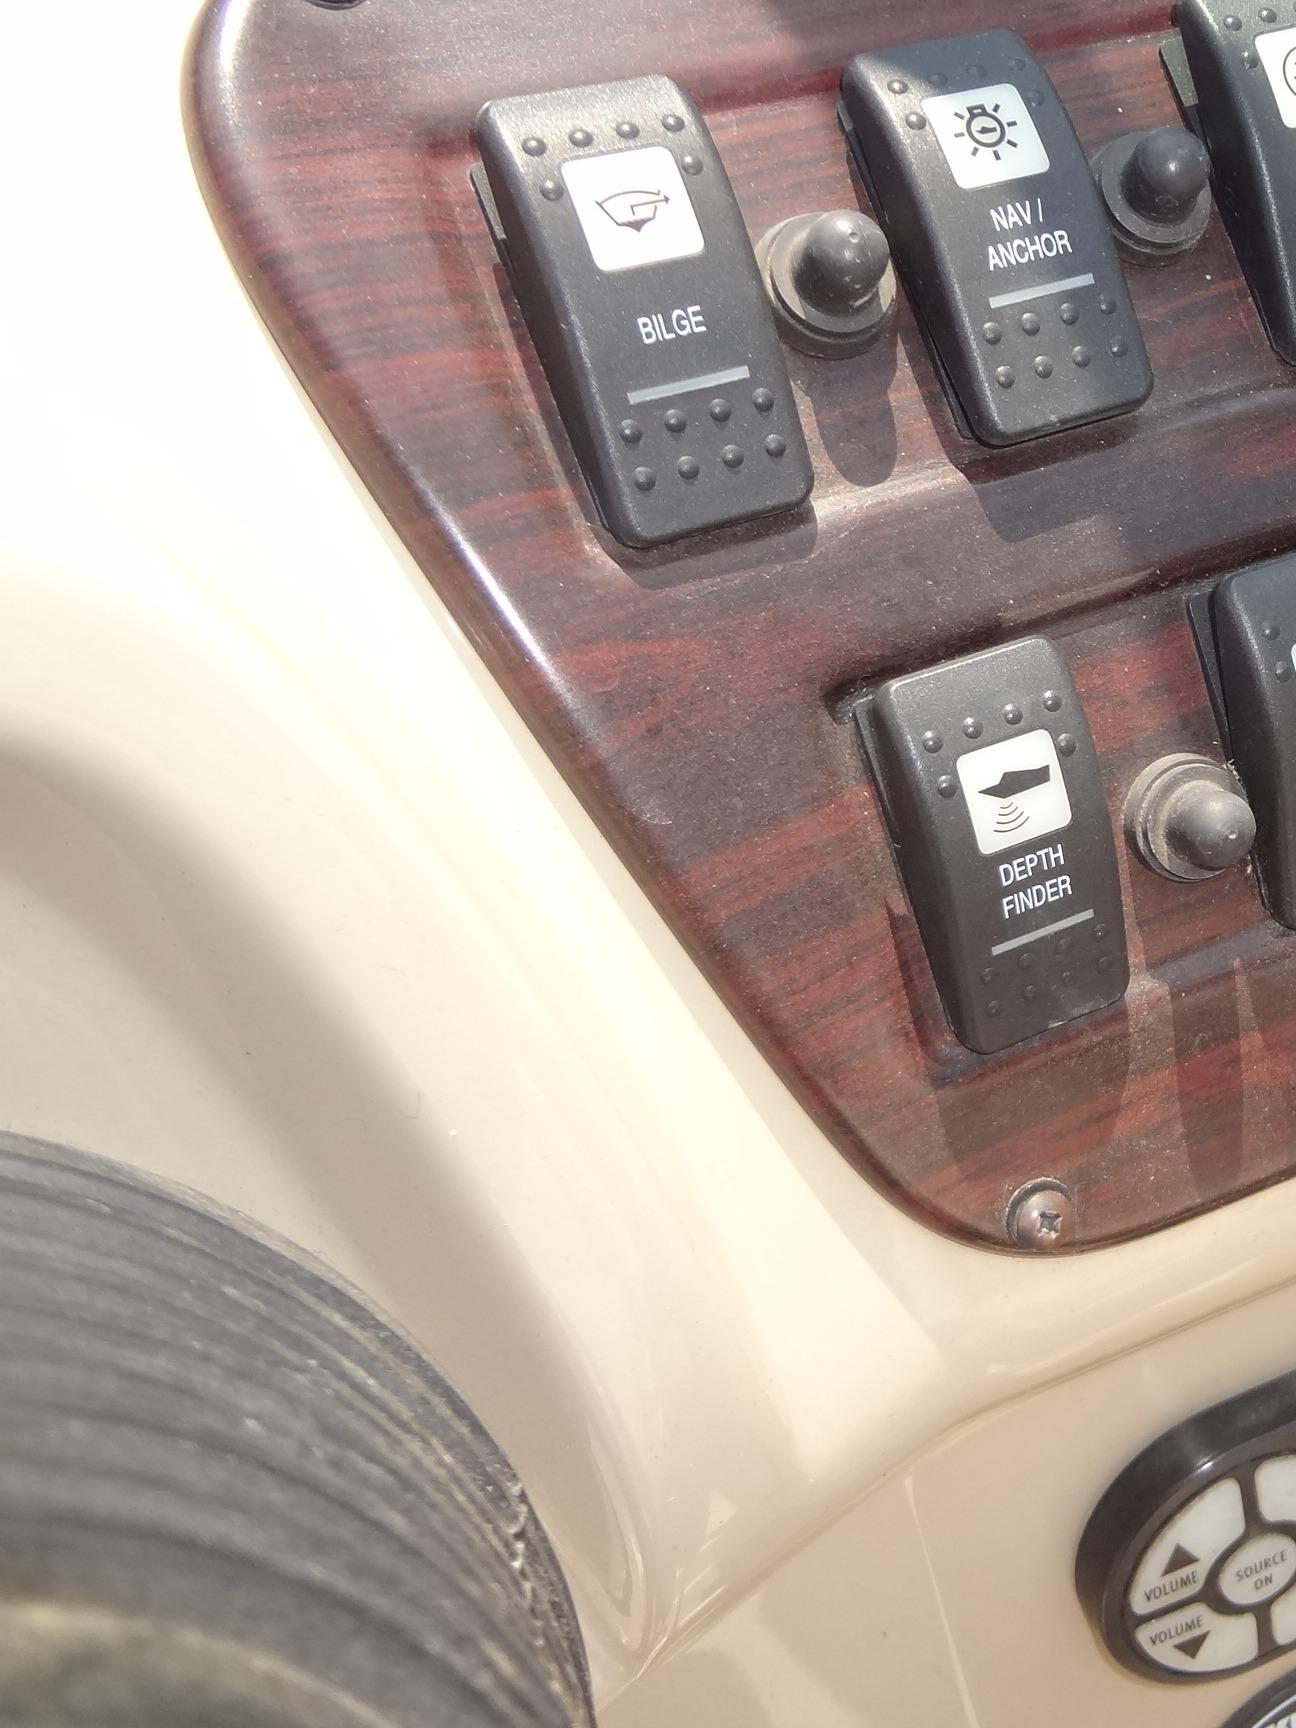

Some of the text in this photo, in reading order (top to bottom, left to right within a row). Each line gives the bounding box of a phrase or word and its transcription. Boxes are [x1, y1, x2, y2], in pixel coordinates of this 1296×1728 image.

[987, 231, 1072, 270] ANCHOR
[637, 305, 706, 344] BILGE
[999, 844, 1065, 887] DEPTH
[1002, 875, 1073, 919] FINDER
[1235, 1549, 1288, 1583] SOURCE
[1253, 1573, 1274, 1591] ON
[1143, 1570, 1198, 1603] VOLUME
[1149, 1615, 1204, 1646] VOLUME
